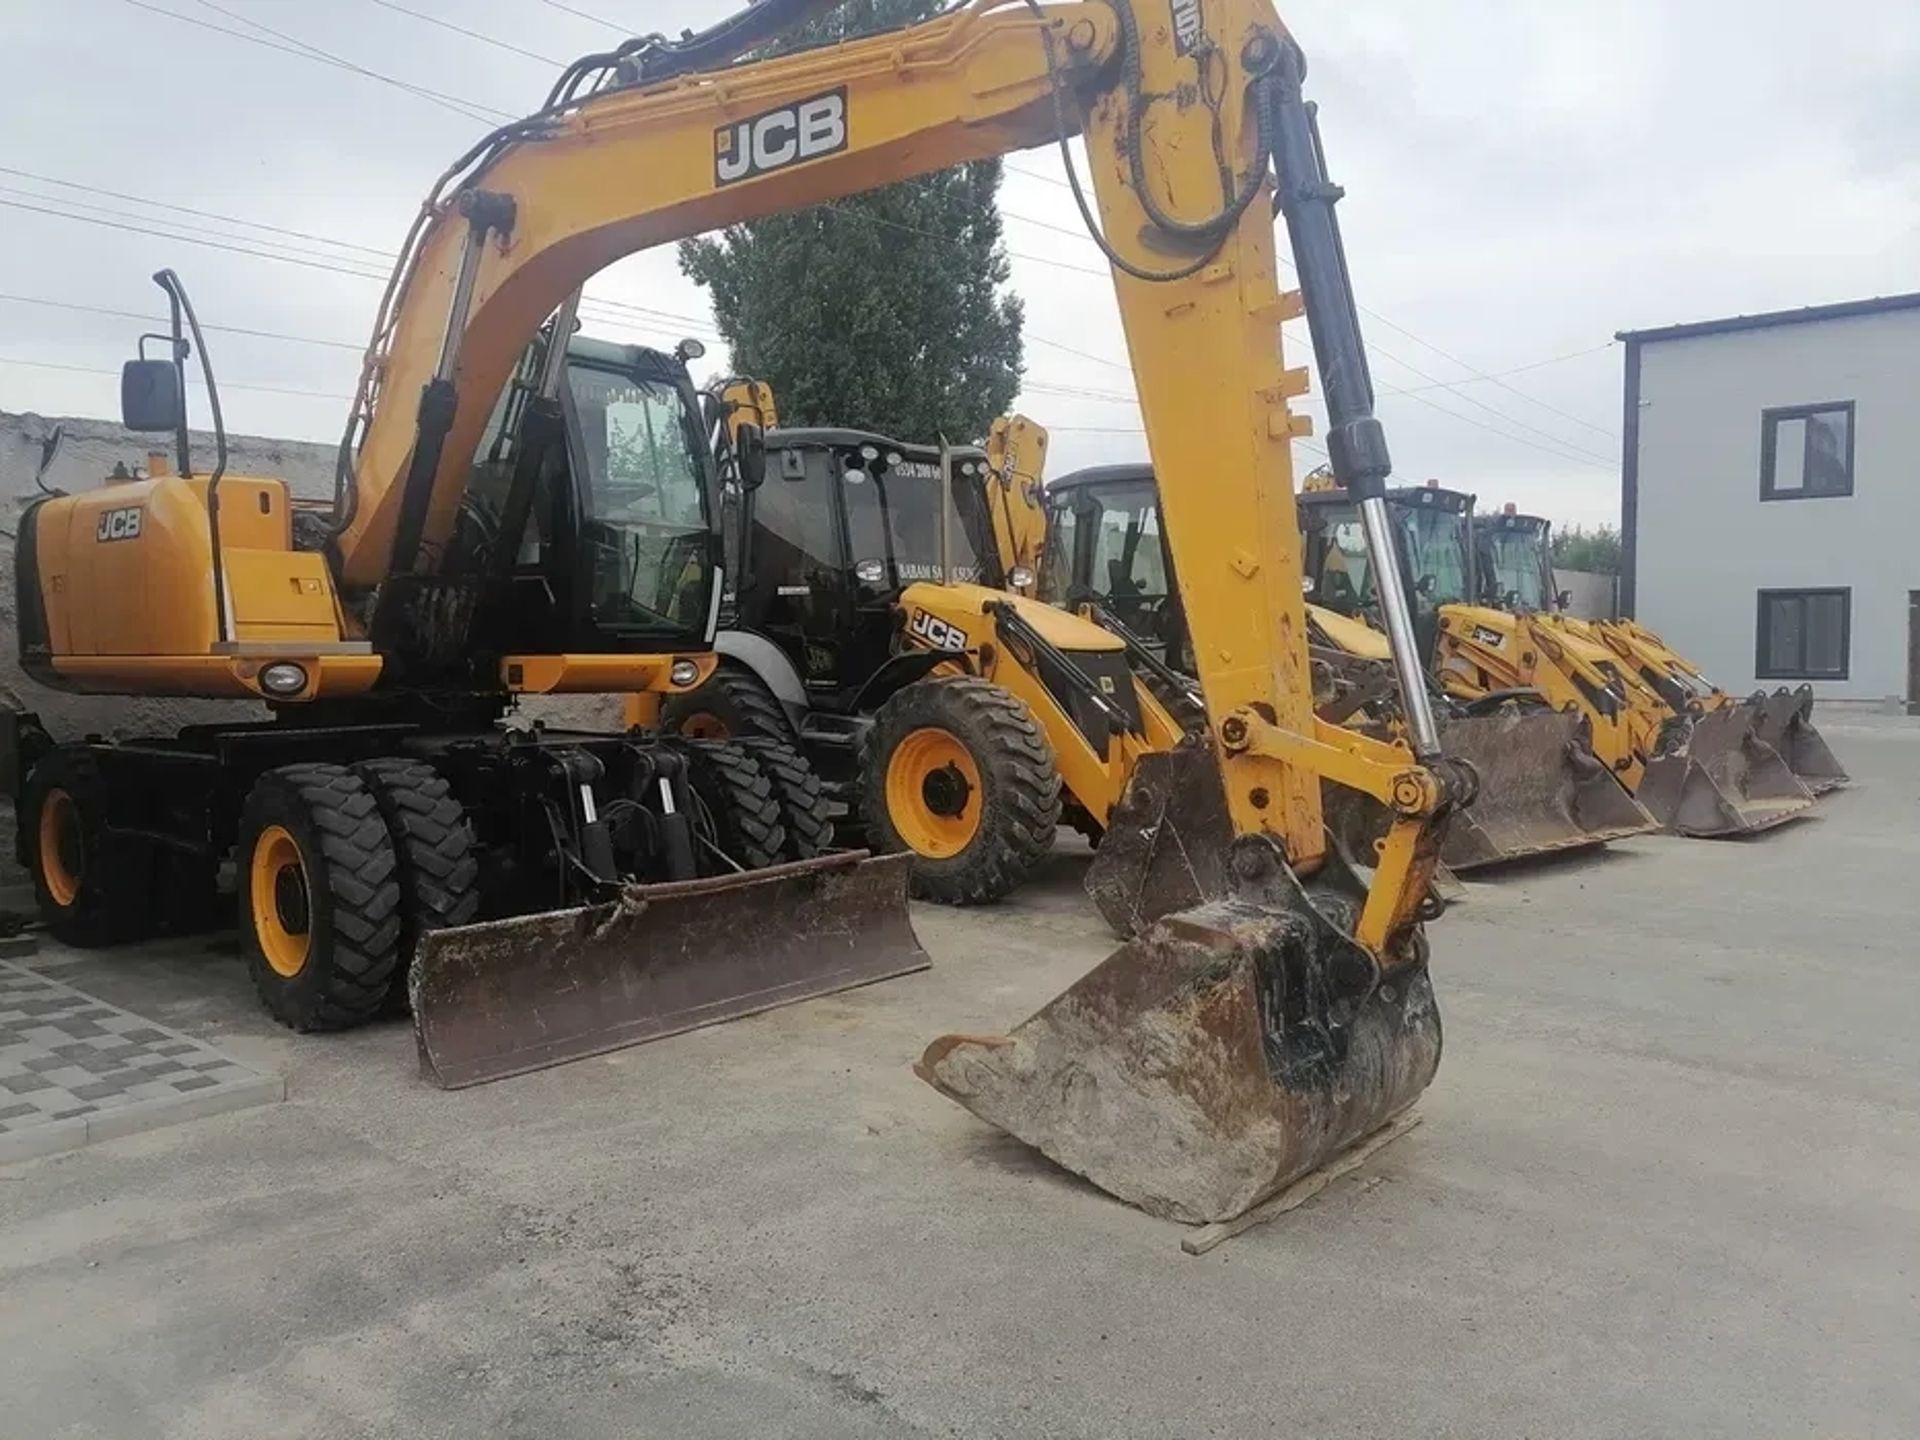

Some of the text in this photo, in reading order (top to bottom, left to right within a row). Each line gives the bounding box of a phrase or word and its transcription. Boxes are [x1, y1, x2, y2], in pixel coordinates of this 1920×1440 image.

[717, 94, 845, 180] JCB
[98, 507, 141, 541] JCB
[913, 613, 966, 650] JCB
